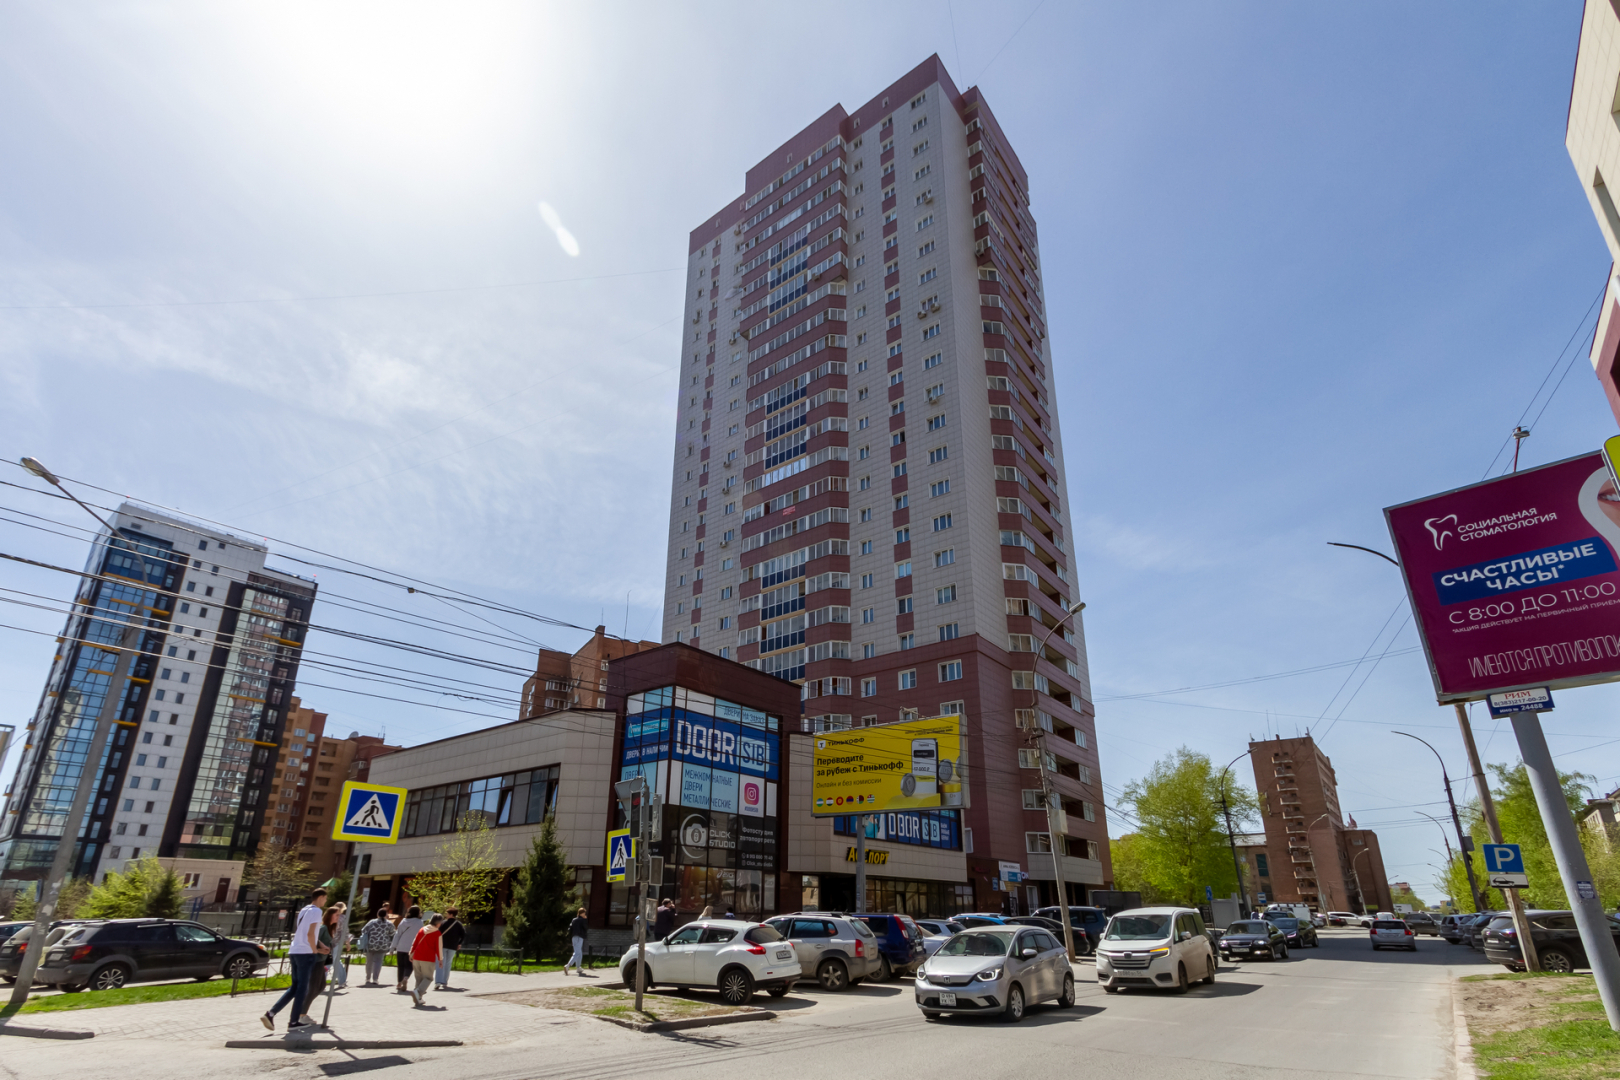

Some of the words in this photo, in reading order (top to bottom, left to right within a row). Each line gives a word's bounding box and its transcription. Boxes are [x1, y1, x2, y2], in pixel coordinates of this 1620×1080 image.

[1457, 507, 1538, 533] СОЦИАЛЬНАЯ
[1460, 512, 1558, 542] СТОМАТОЛОГИЯ
[1440, 543, 1597, 586] СЧАСТЛИВЫЕ
[1449, 611, 1465, 624] С
[1468, 601, 1515, 621] 8:00
[1521, 593, 1558, 614] ДО
[1560, 581, 1616, 603] 11:00
[1480, 616, 1523, 629] ДЕЙСТВУЕТ
[1536, 604, 1589, 619] ПЕРВИЧНЫЙ
[1468, 648, 1537, 678] ИМЕЮТСЯ
[1504, 690, 1531, 700] РИМ
[676, 719, 735, 765] DOOR
[743, 741, 764, 767] SIB
[828, 737, 865, 747] ТИНЬКОФФ
[816, 769, 825, 777] за
[826, 766, 851, 777] рубеж
[858, 760, 904, 772] Тинькофф
[817, 754, 864, 766] Переводите
[684, 769, 733, 786] МЕЖКОМНАТНЫЕ
[853, 778, 882, 786] комиссии
[684, 781, 703, 792] ДВЕРИ
[683, 793, 732, 809] МЕТАЛЛИЧЕСКИЕ
[709, 829, 731, 838] CLICK
[888, 812, 920, 839] DOOR
[709, 839, 736, 849] STUDIO
[1493, 847, 1515, 870] P
